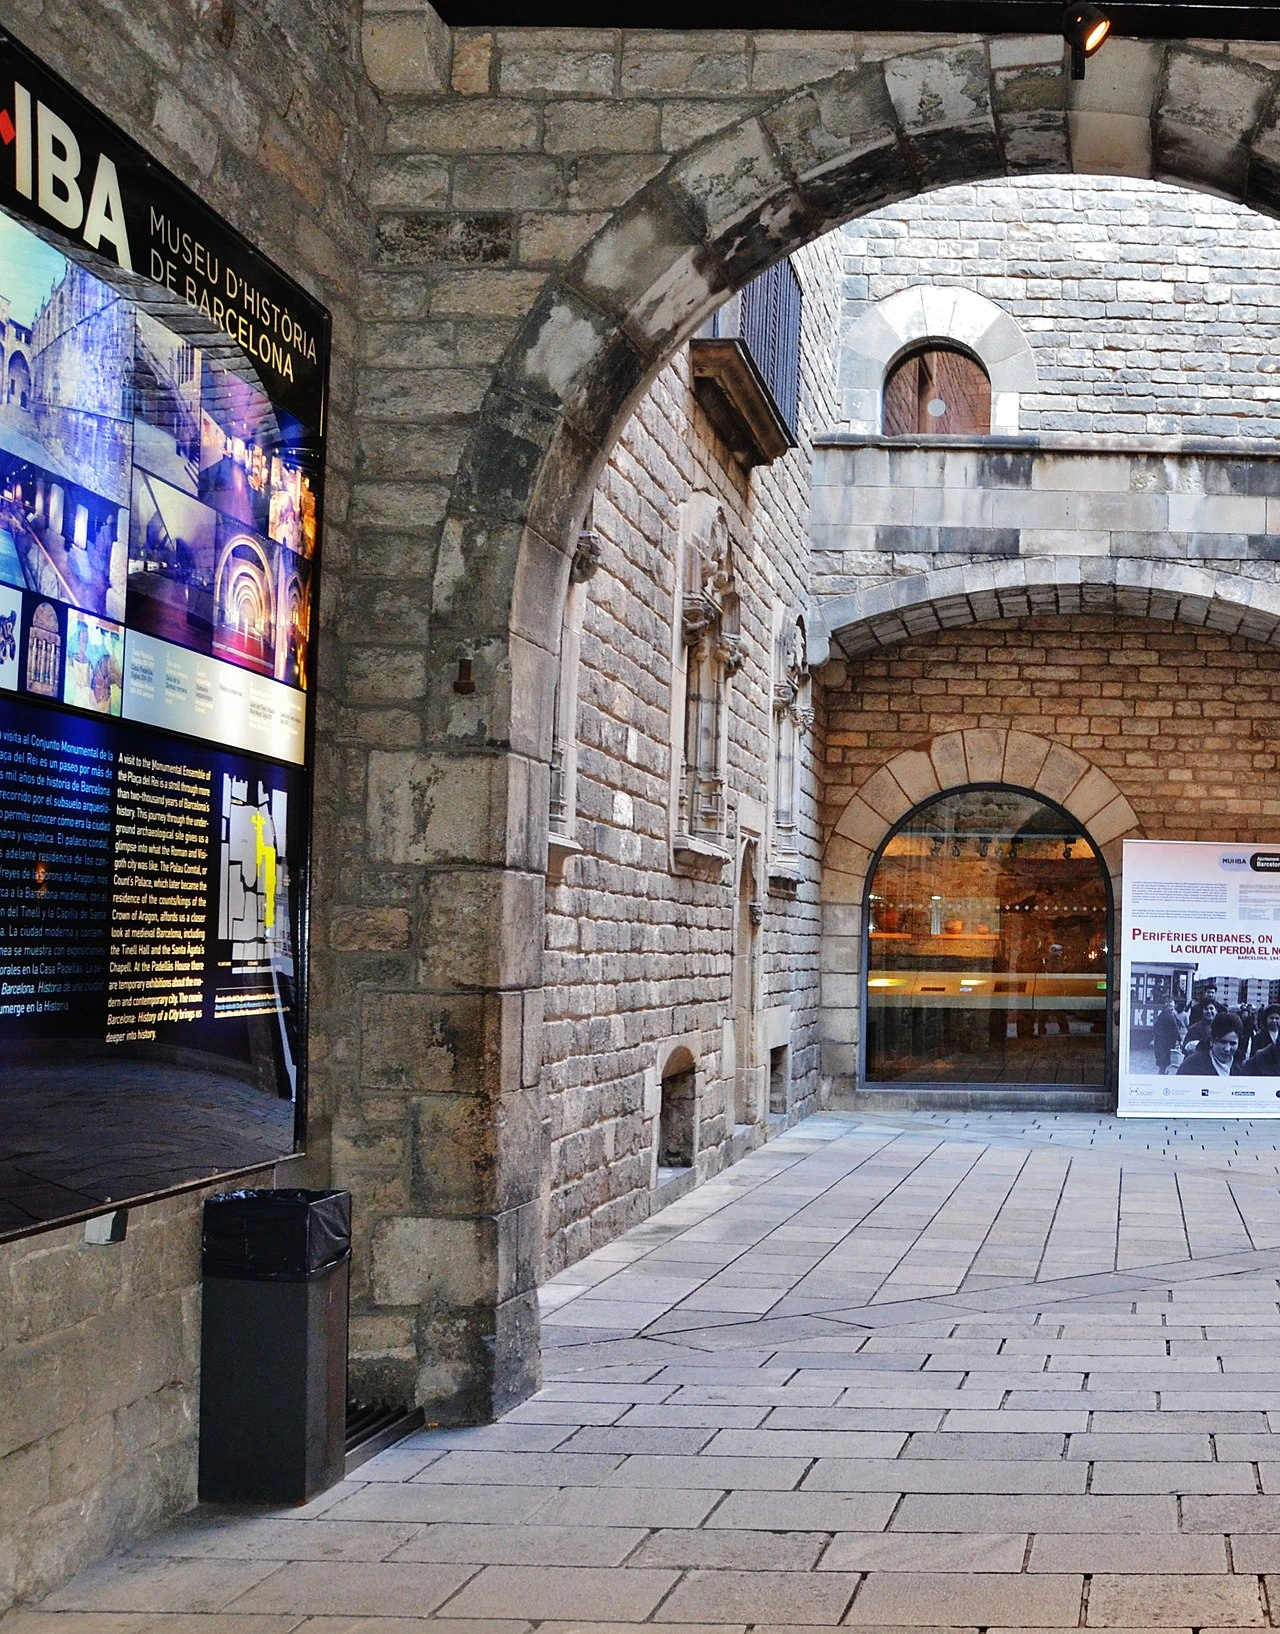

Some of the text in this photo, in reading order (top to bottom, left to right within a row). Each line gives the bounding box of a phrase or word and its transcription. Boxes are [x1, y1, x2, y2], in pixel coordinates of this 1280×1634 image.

[150, 205, 317, 365] MUSEU D'HISTÒRIA
[150, 248, 295, 383] DE BARCELONA
[3, 729, 113, 761] visita al Conjunto Monumental de la
[14, 752, 112, 779] del Rei es un paseo por más de
[118, 753, 211, 780] A visit to the Monumental Ensemble of
[6, 770, 17, 781] mil
[19, 772, 35, 784] años
[37, 774, 44, 785] de
[46, 776, 70, 790] historia
[72, 780, 79, 791] de
[118, 770, 127, 782] the
[128, 771, 141, 786] Plaça
[142, 775, 150, 785] del
[151, 775, 159, 787] Rei
[168, 781, 180, 790] stroll
[181, 782, 198, 797] through
[198, 787, 210, 797] more
[33, 794, 44, 805] por
[46, 795, 52, 805] el
[54, 796, 81, 810] subsuelo
[117, 787, 210, 812] than two-thousand years of Barcelona's
[4, 810, 30, 821] permite
[32, 814, 56, 824] conocer
[75, 819, 84, 829] era
[86, 818, 91, 829] la
[92, 820, 110, 831] ciudad
[137, 807, 147, 819] This
[147, 809, 167, 824] journey
[167, 813, 185, 827] through
[194, 817, 209, 827] under-
[65, 834, 87, 847] palacio
[1222, 857, 1247, 865] MUHBA
[1131, 927, 1273, 945] PERIFÈRIES URBANES, ON
[1170, 944, 1183, 954] LA
[1185, 944, 1218, 955] CIUTAT
[1219, 945, 1256, 955] PERDIA
[1258, 946, 1270, 955] EL
[27, 1004, 35, 1013] en
[36, 1001, 42, 1012] la
[106, 1029, 156, 1044] deeper into history.
